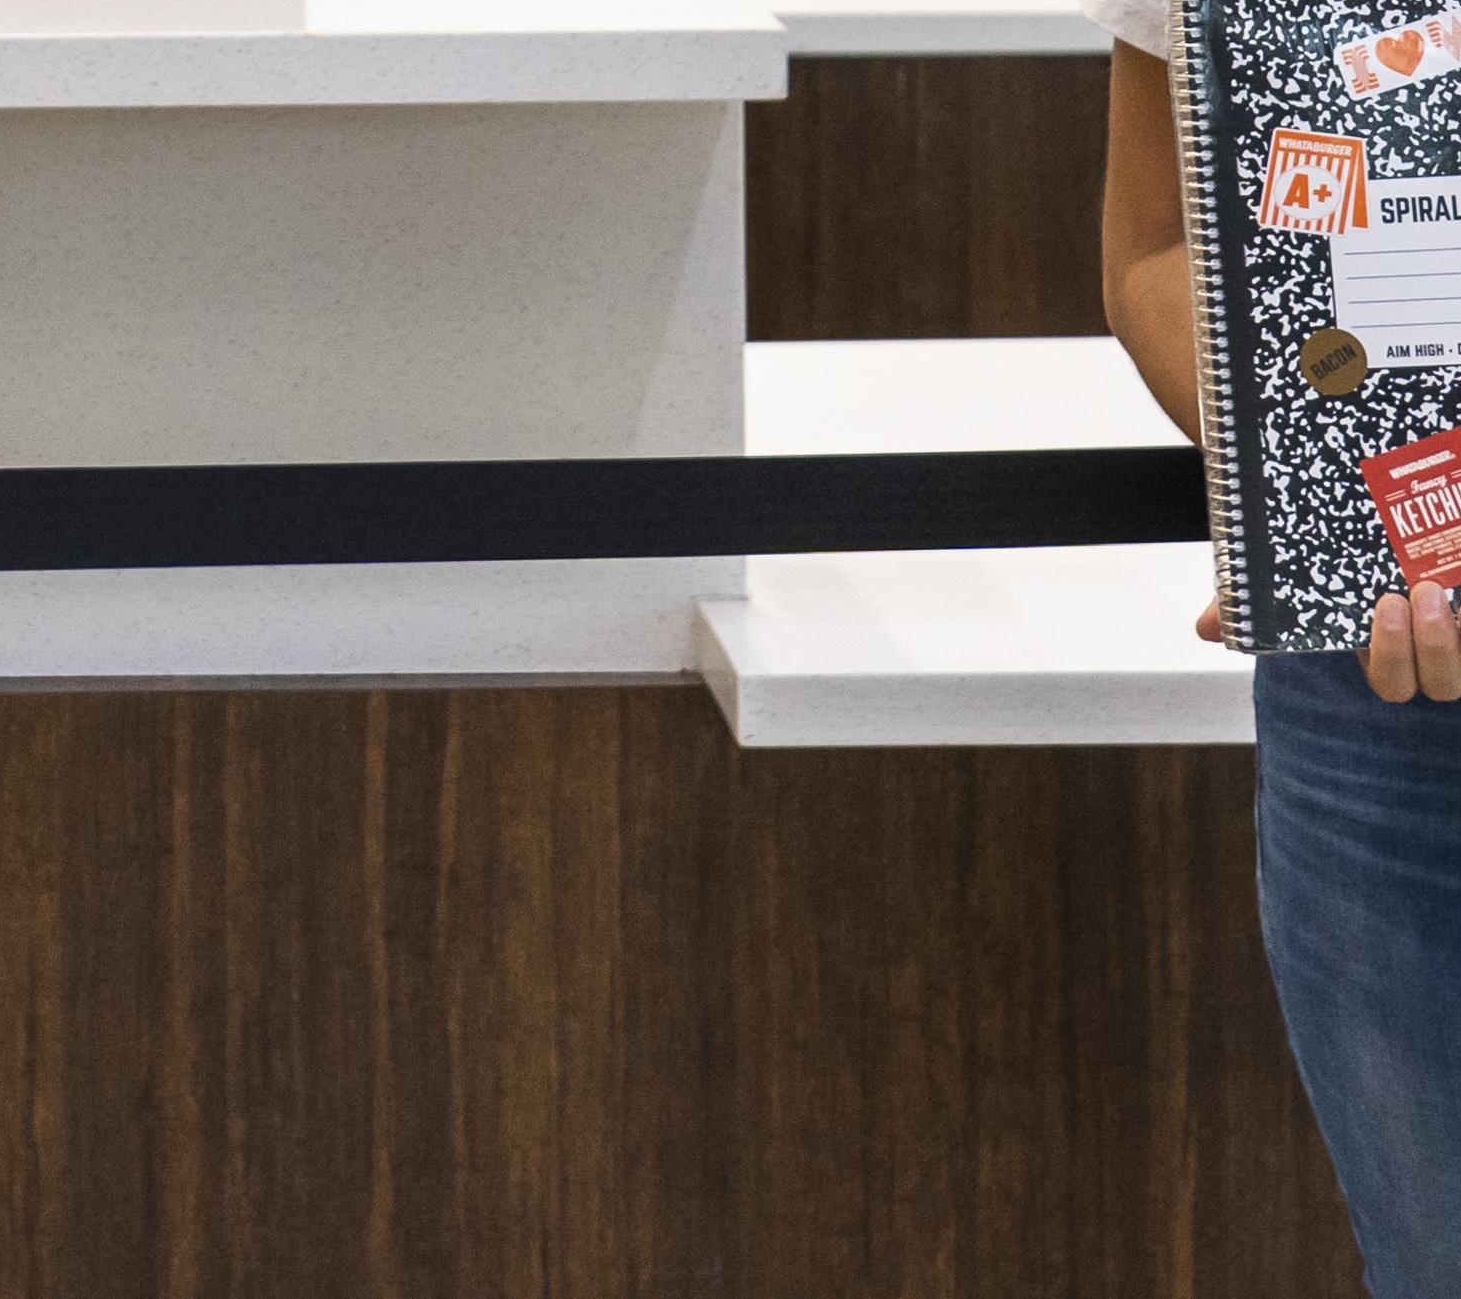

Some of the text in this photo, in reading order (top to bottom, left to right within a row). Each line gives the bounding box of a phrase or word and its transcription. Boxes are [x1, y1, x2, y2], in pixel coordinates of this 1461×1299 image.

[1279, 137, 1352, 156] WHATABURGER
[1283, 172, 1333, 209] A+
[1310, 343, 1357, 380] BACON
[1386, 345, 1412, 359] AIM
[1415, 343, 1444, 358] HIGH
